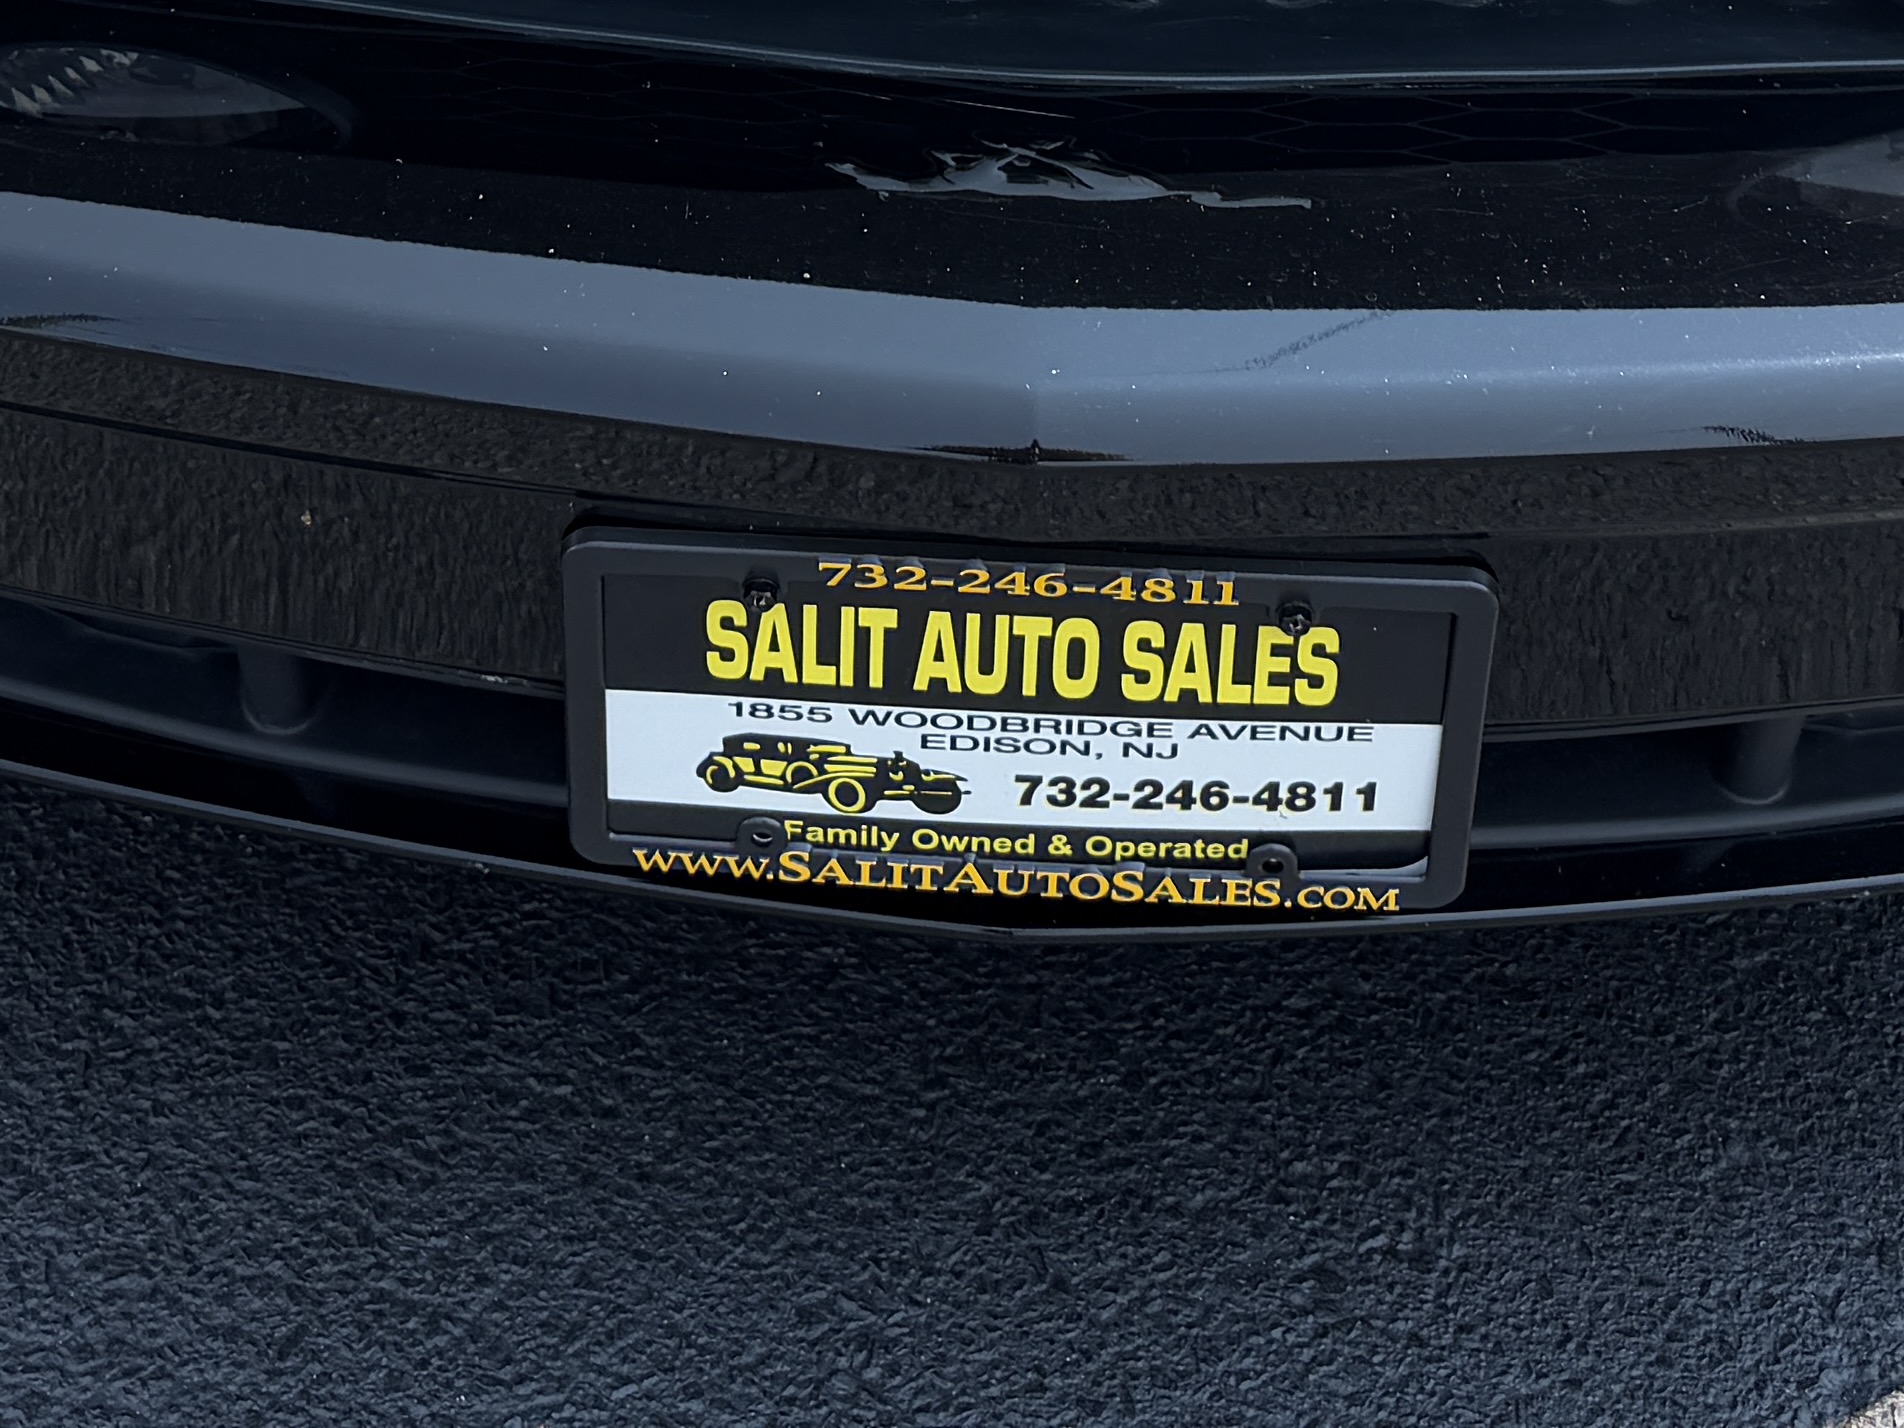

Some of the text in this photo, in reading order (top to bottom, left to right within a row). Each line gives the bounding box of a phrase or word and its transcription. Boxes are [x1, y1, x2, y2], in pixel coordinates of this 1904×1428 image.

[818, 558, 1239, 606] 732-246-4811
[706, 599, 1340, 706] SALIT AUTO SALES
[728, 701, 1374, 743] 1855 WOODBRIDGE AVENUE
[920, 733, 1178, 760] EDISON, NJ
[1014, 774, 1378, 812] 732-246-4811
[784, 820, 1248, 862] Family Owned & Operated
